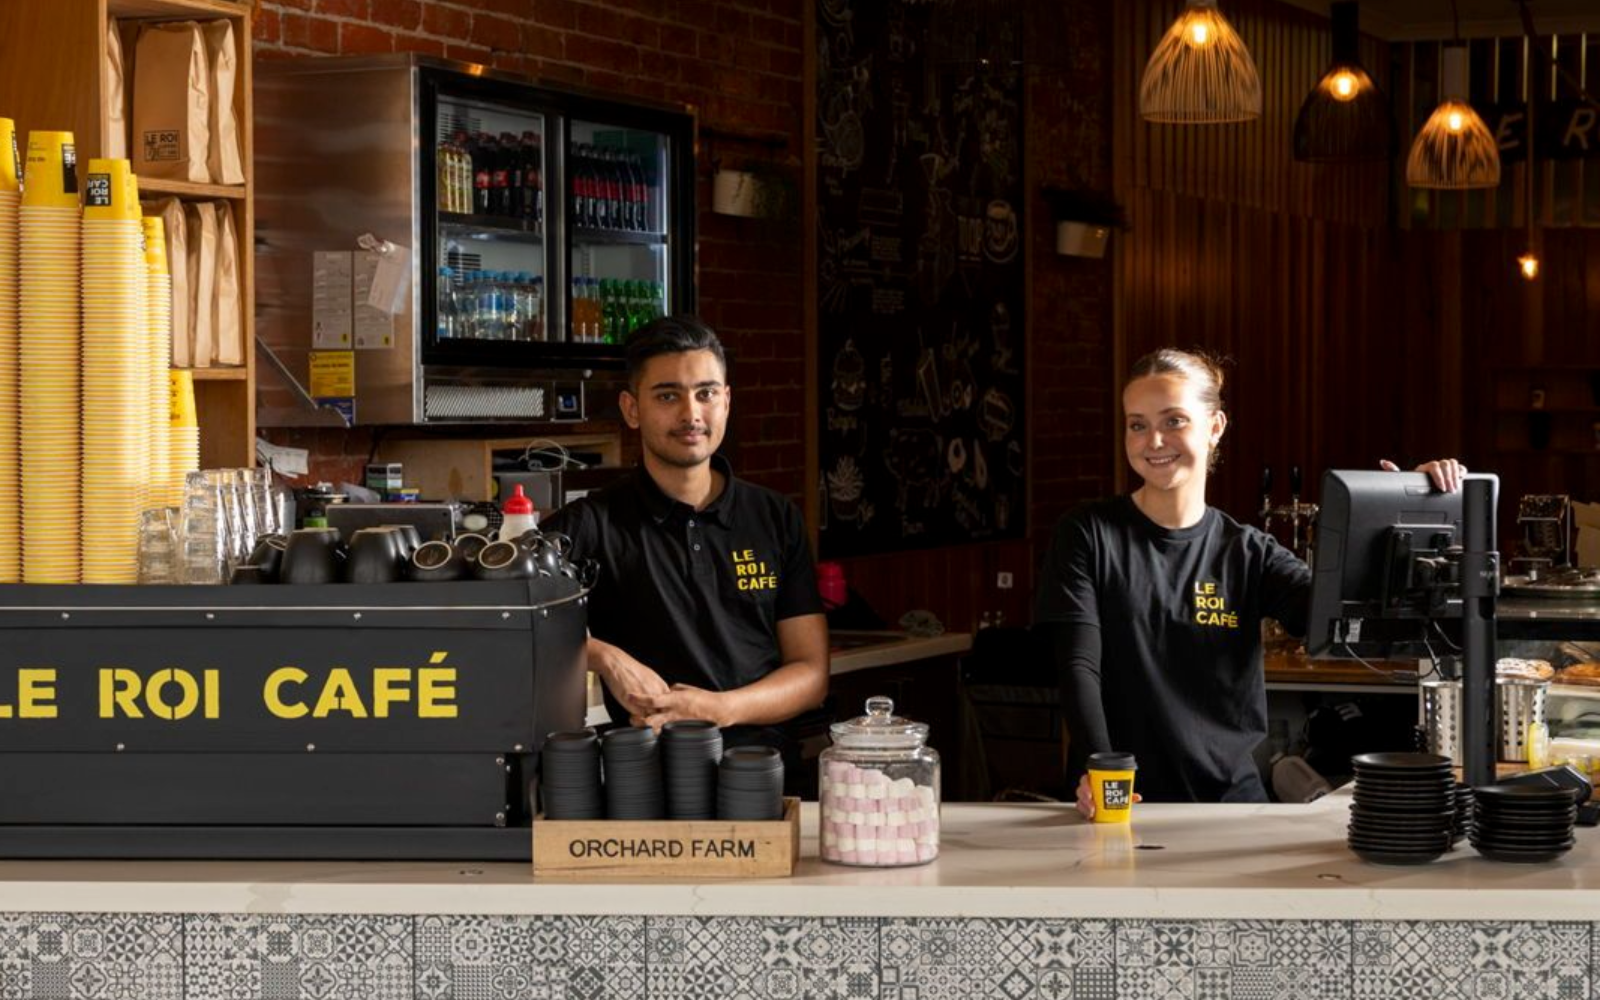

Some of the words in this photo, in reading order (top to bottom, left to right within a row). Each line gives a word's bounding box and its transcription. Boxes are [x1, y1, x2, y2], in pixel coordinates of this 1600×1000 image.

[160, 133, 177, 142] ROI
[88, 179, 108, 188] CAF
[90, 188, 109, 196] ROI
[95, 197, 109, 205] LE
[732, 549, 755, 562] LE
[735, 561, 765, 576] ROI
[737, 571, 778, 590] CAFÉ
[1194, 581, 1215, 594] LE
[1195, 596, 1224, 610] ROI
[1196, 611, 1239, 628] CAFÉ
[99, 667, 220, 720] ROI
[263, 651, 459, 720] CAFÉ
[1105, 781, 1118, 789] LE
[1105, 789, 1123, 797] ROI
[568, 839, 683, 858] ORCHARD
[691, 839, 756, 858] FARM
